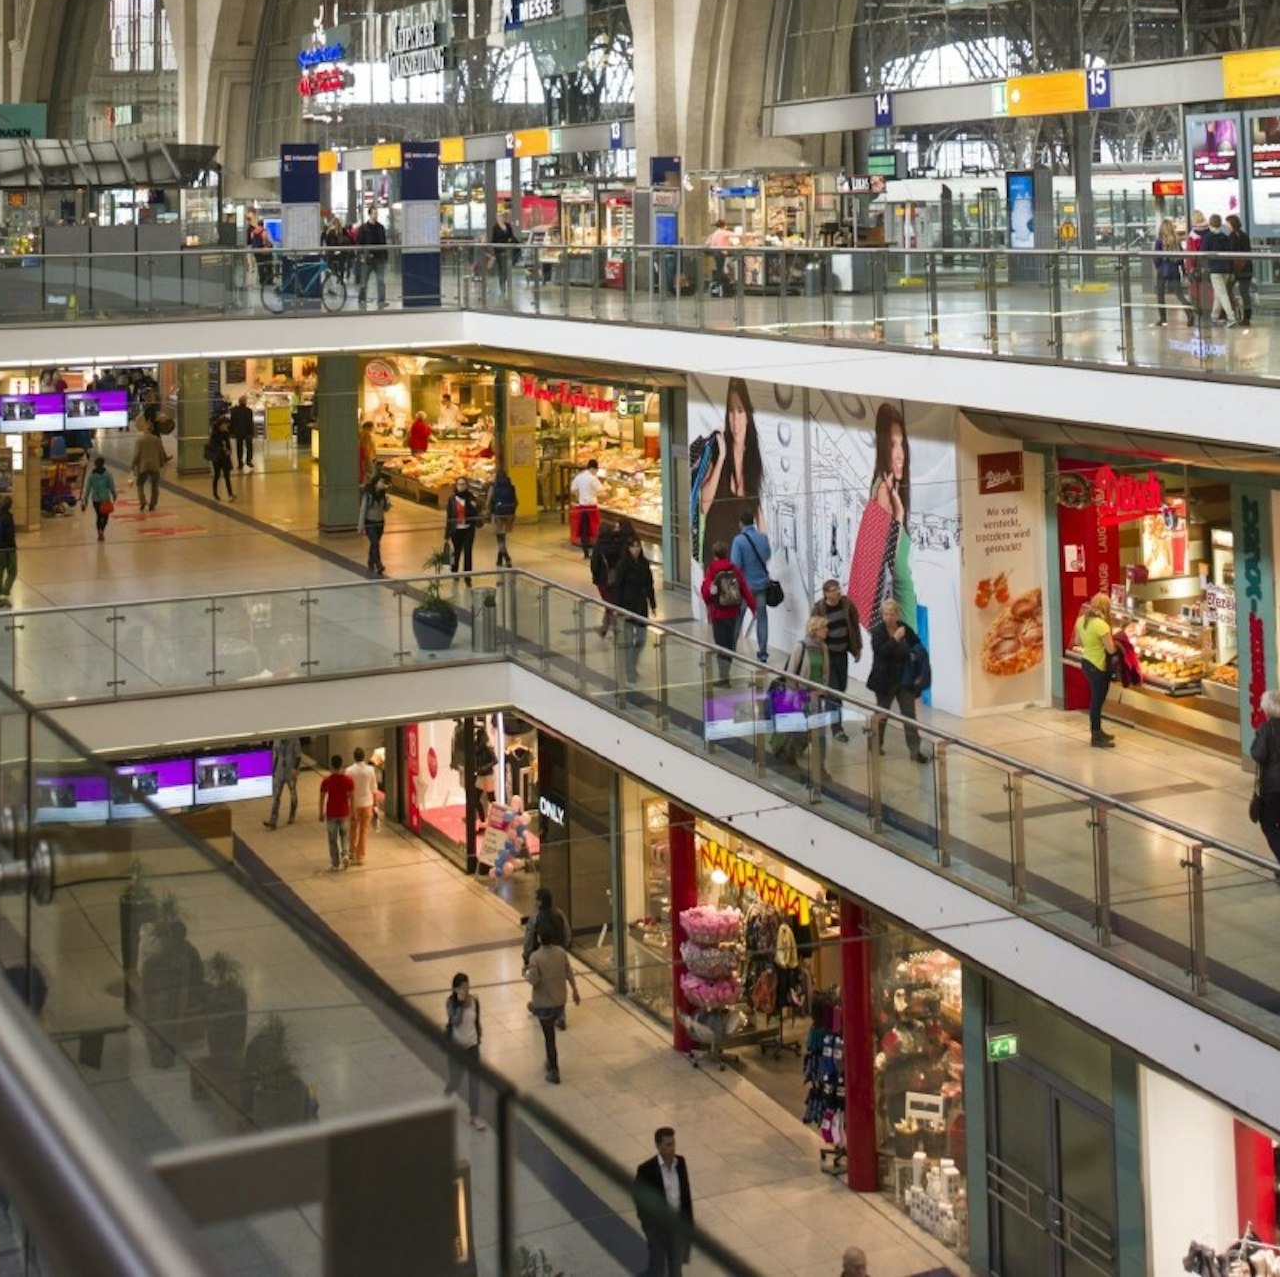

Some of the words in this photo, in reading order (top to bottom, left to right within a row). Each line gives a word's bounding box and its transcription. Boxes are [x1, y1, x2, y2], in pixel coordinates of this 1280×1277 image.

[1088, 69, 1106, 95] 15
[876, 93, 889, 115] 14
[611, 122, 620, 138] 13
[505, 133, 515, 147] 12
[1001, 506, 1018, 515] sind
[540, 795, 565, 826] ONLY
